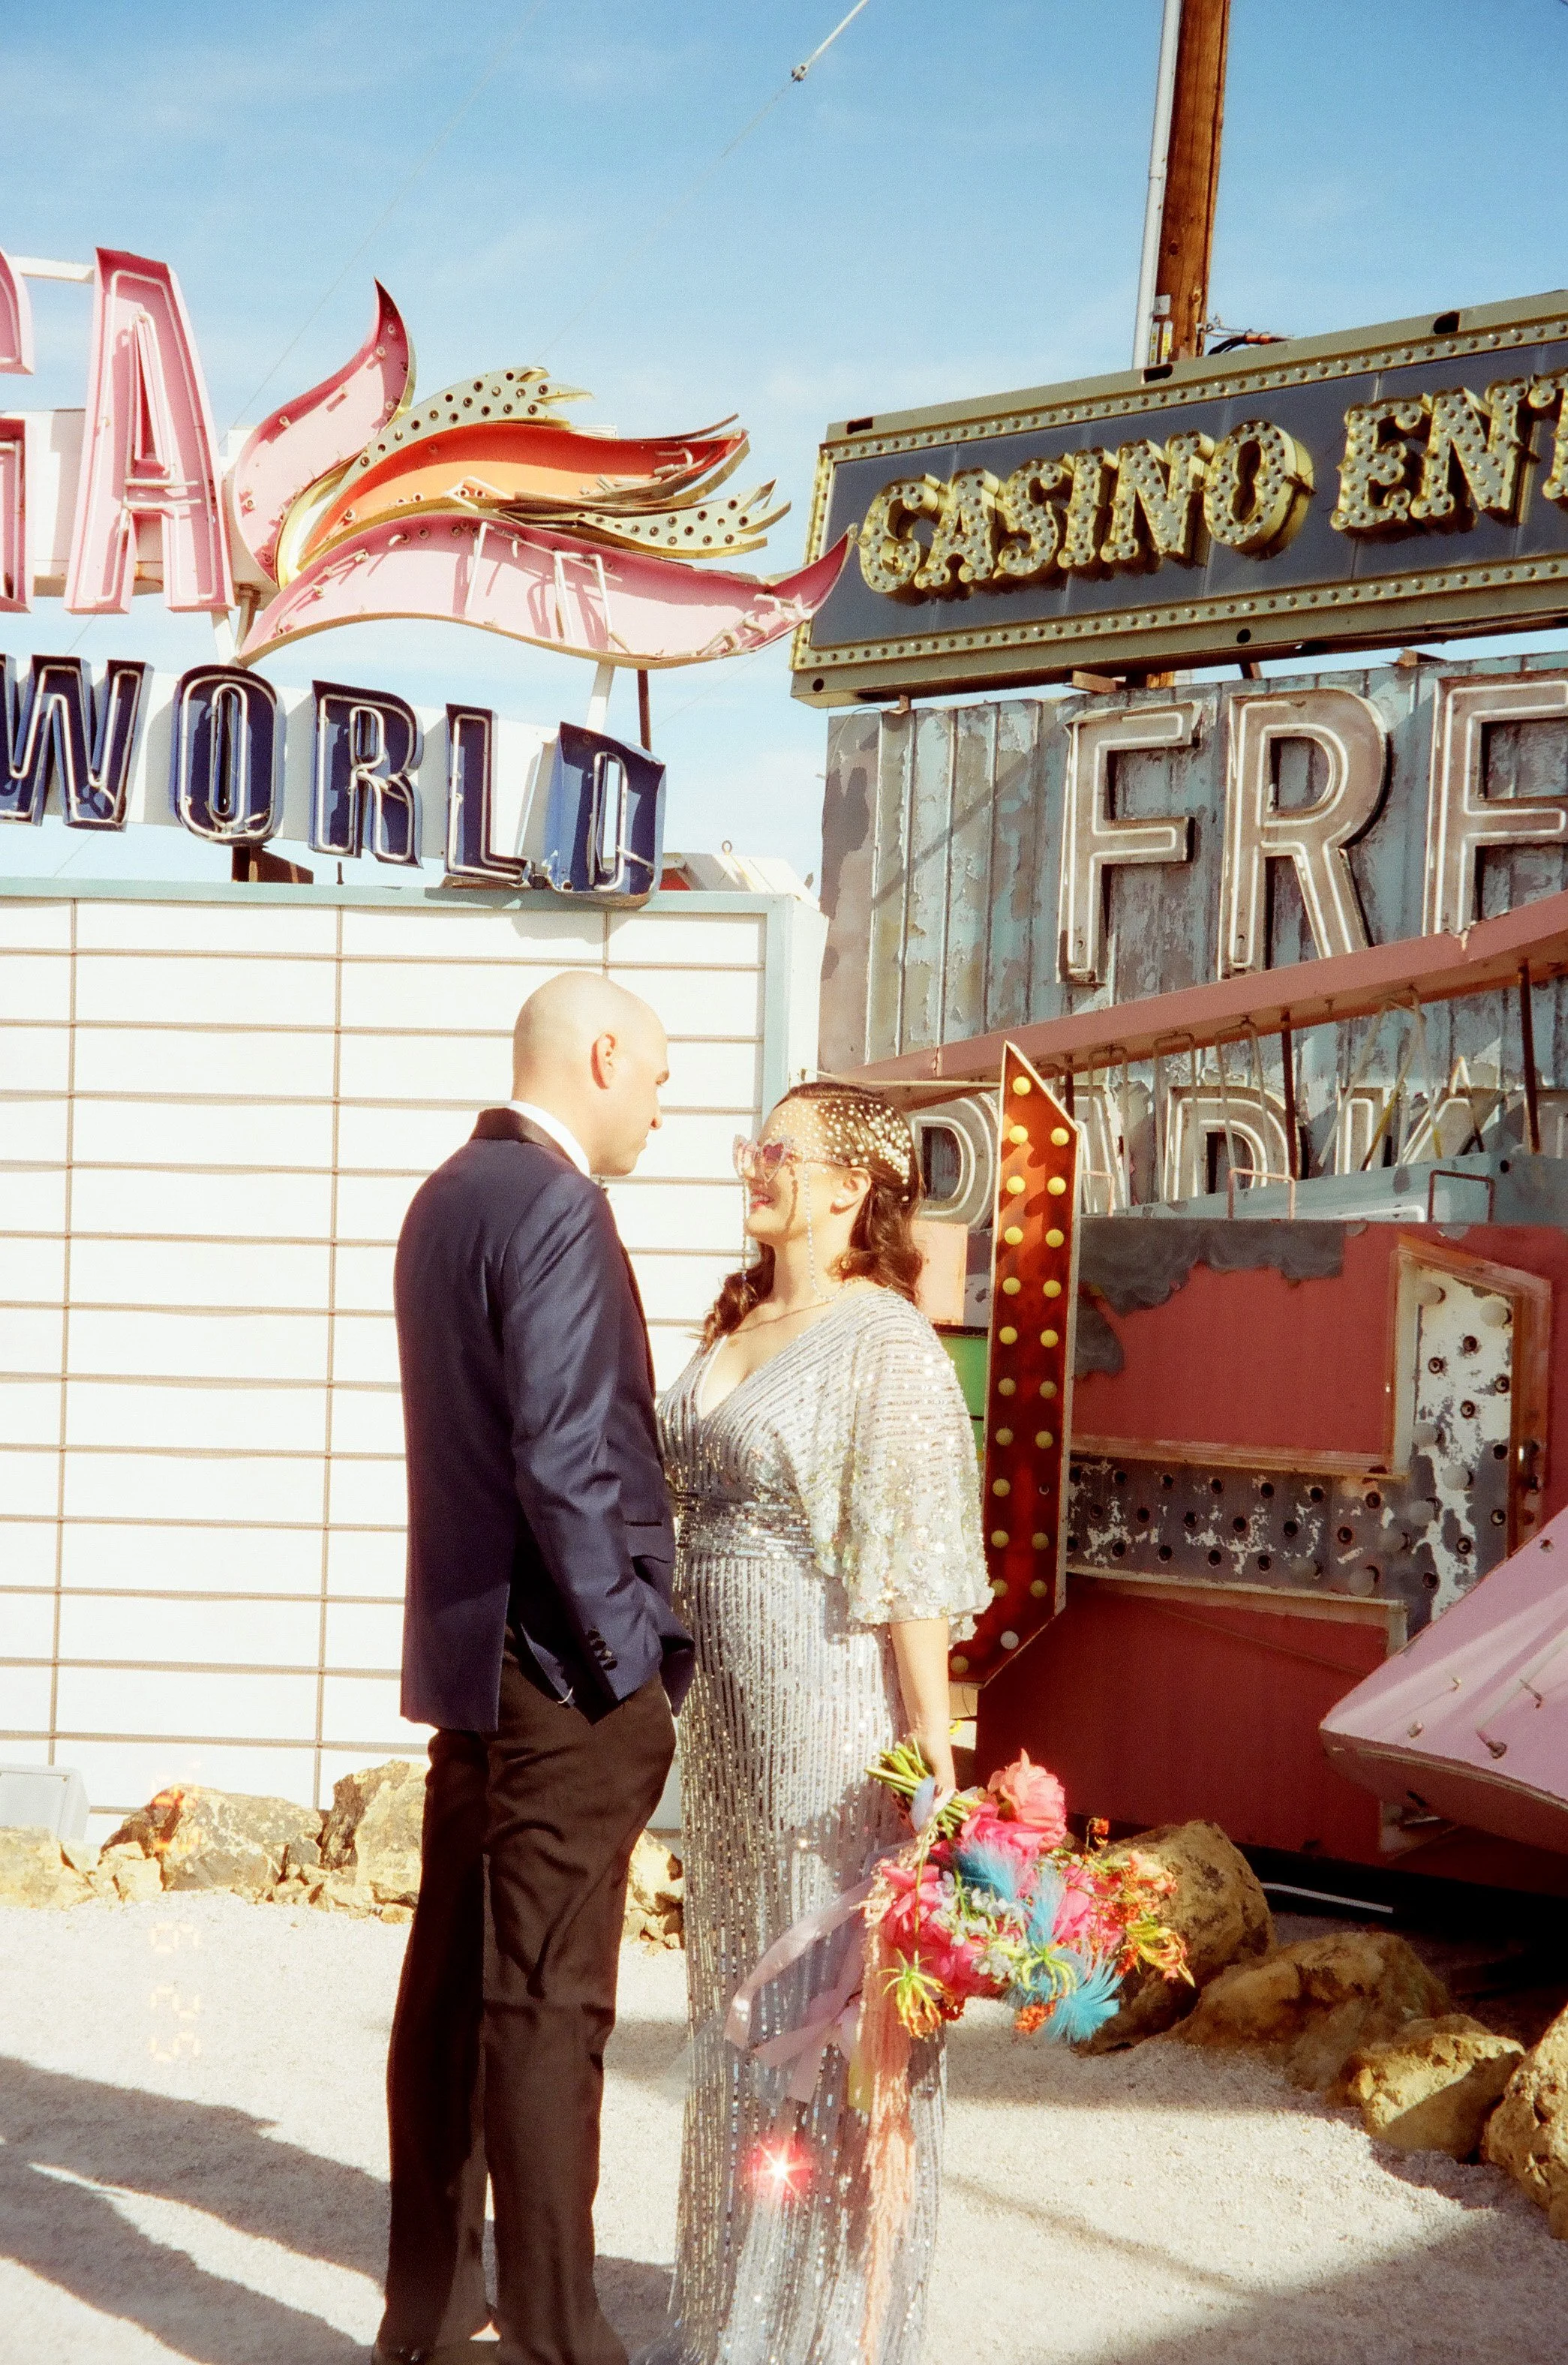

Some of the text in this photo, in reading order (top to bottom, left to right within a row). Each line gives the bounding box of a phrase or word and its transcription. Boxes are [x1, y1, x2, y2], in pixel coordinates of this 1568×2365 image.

[0, 247, 234, 615] A
[858, 417, 1314, 602] CASINO
[0, 653, 667, 908] WORLD
